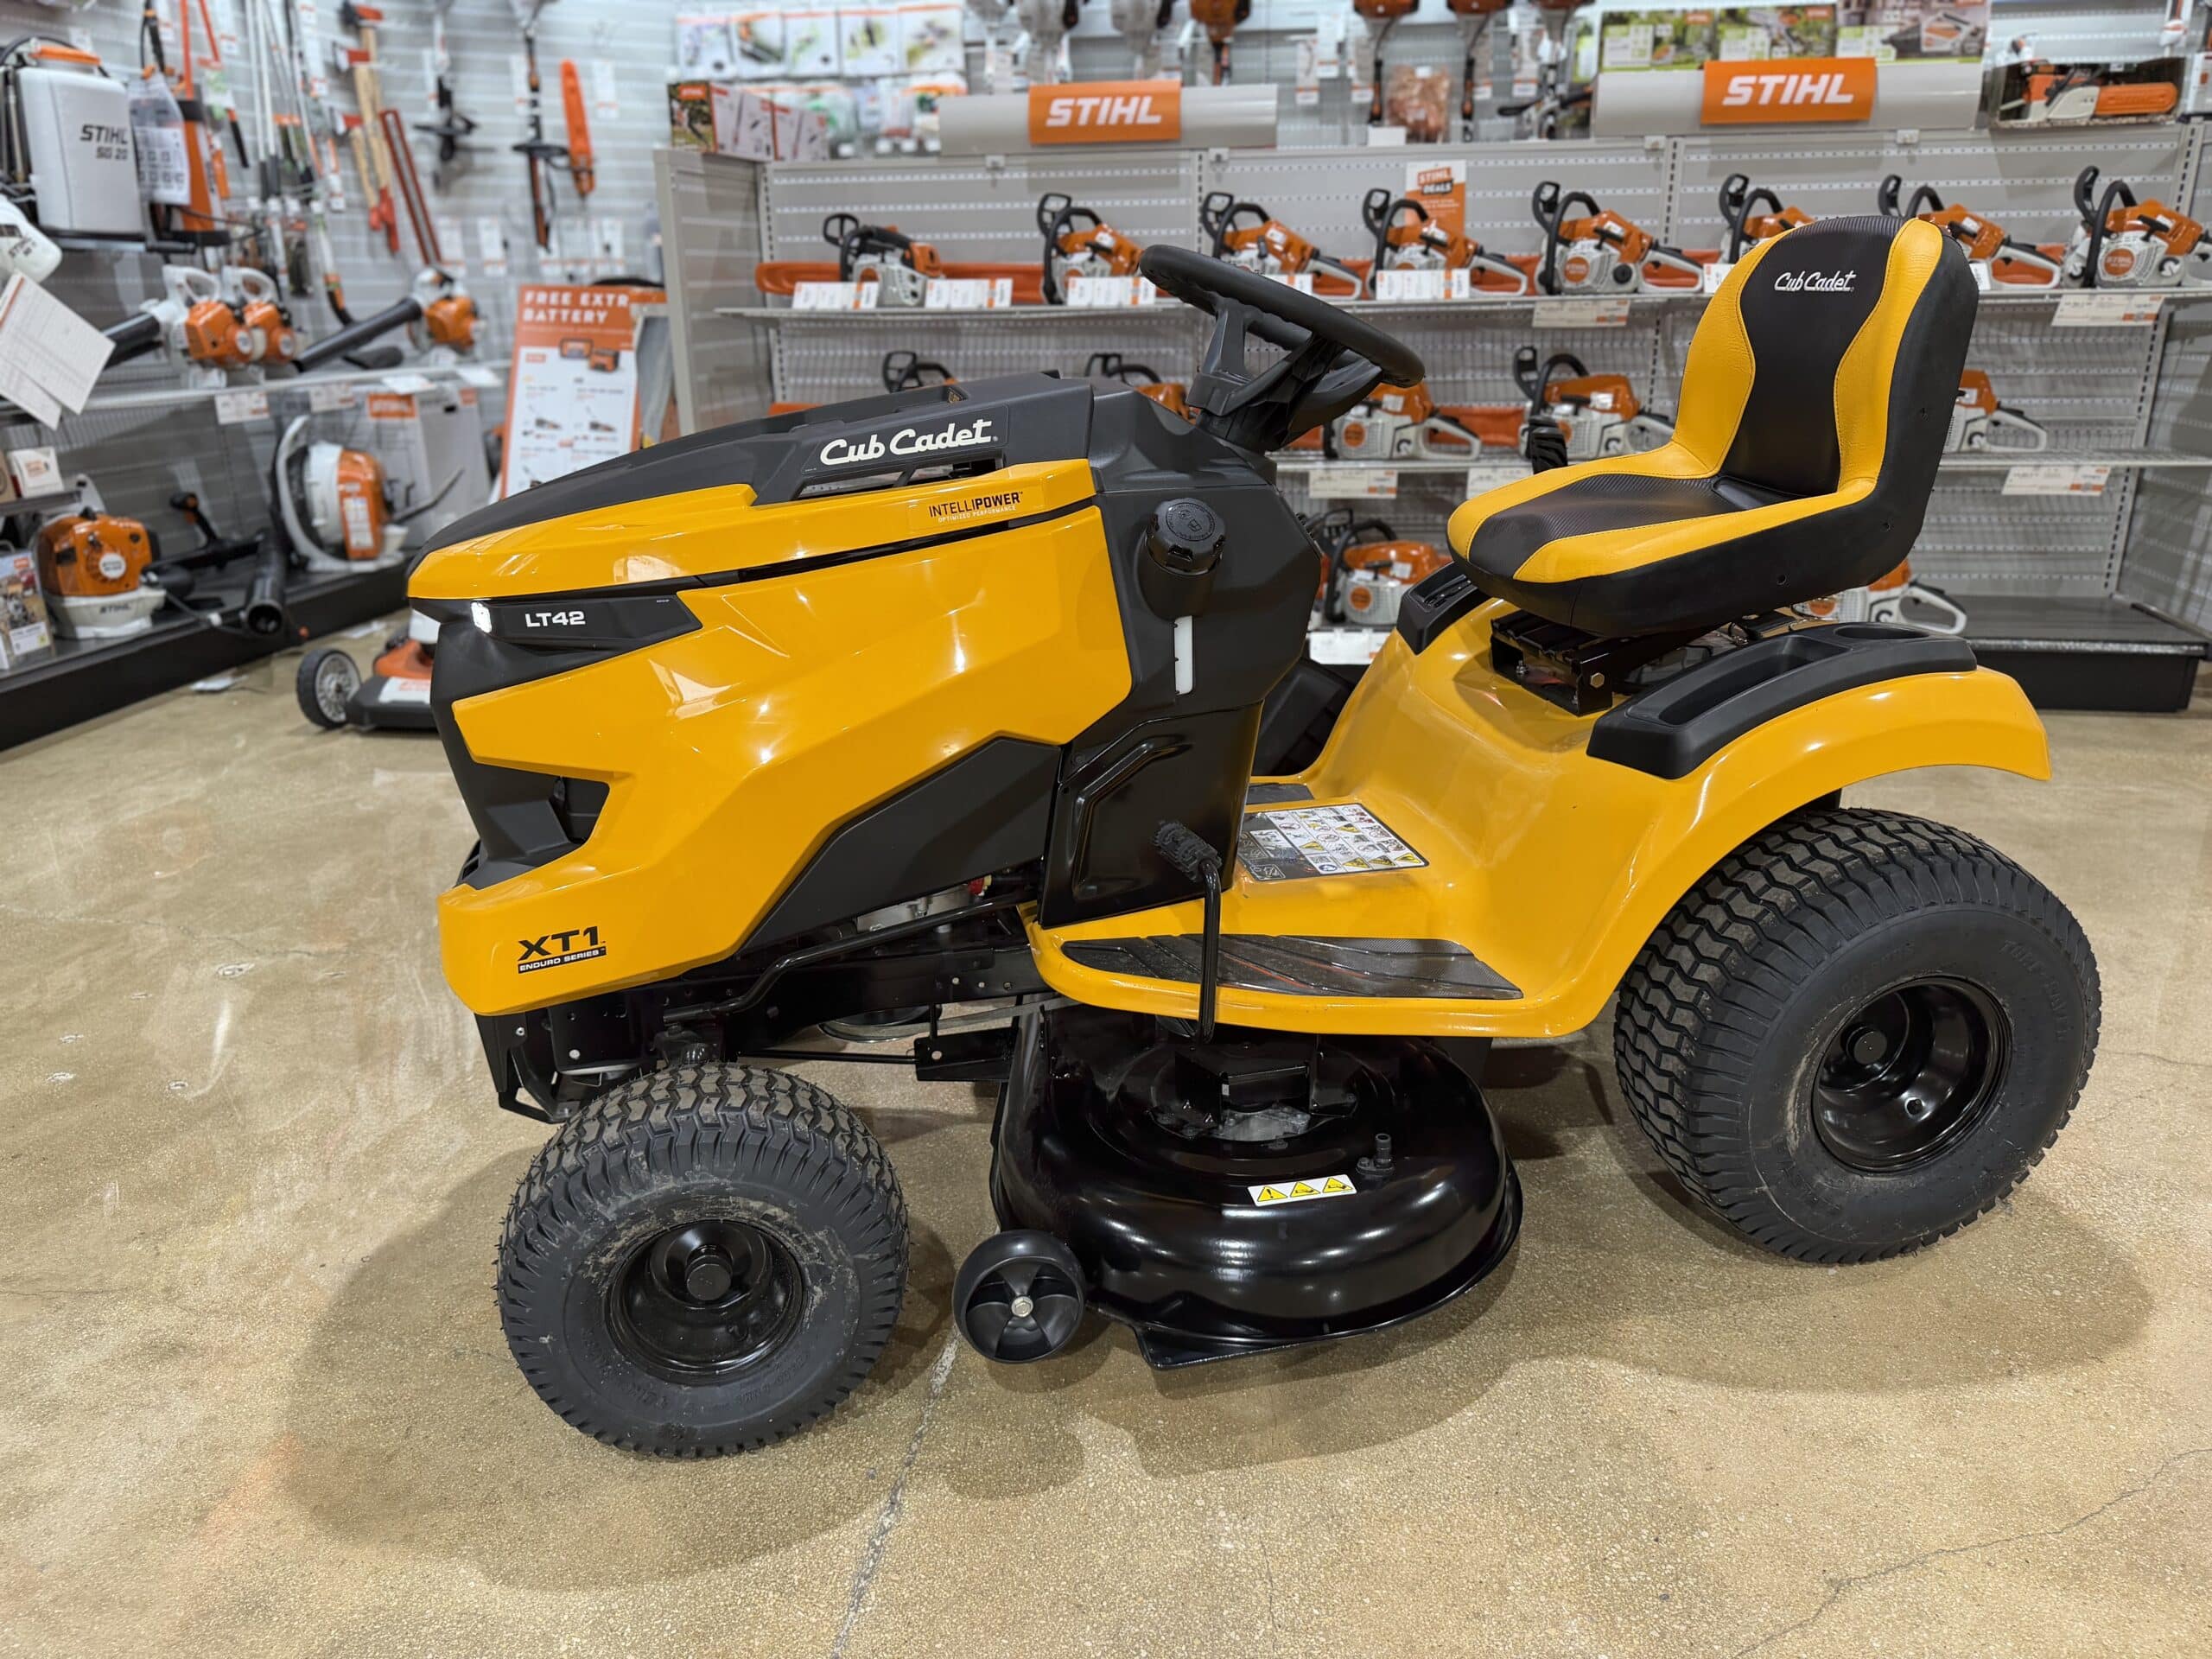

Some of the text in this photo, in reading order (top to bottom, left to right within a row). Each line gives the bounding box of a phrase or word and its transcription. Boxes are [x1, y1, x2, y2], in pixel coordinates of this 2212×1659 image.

[1722, 73, 1854, 105] STIHL
[1046, 95, 1162, 128] STIHL
[80, 124, 128, 145] STIHL
[1774, 270, 1857, 292] Cub Cadet
[524, 290, 629, 308] FREE EXTR
[523, 308, 608, 324] BATTERY
[820, 419, 993, 465] Cub Cadet
[938, 505, 1016, 524] OPTIMIZED PERFORMANCE
[525, 611, 586, 627] LT42
[518, 926, 598, 961] XT1
[519, 950, 600, 972] ENDURO SERIES
